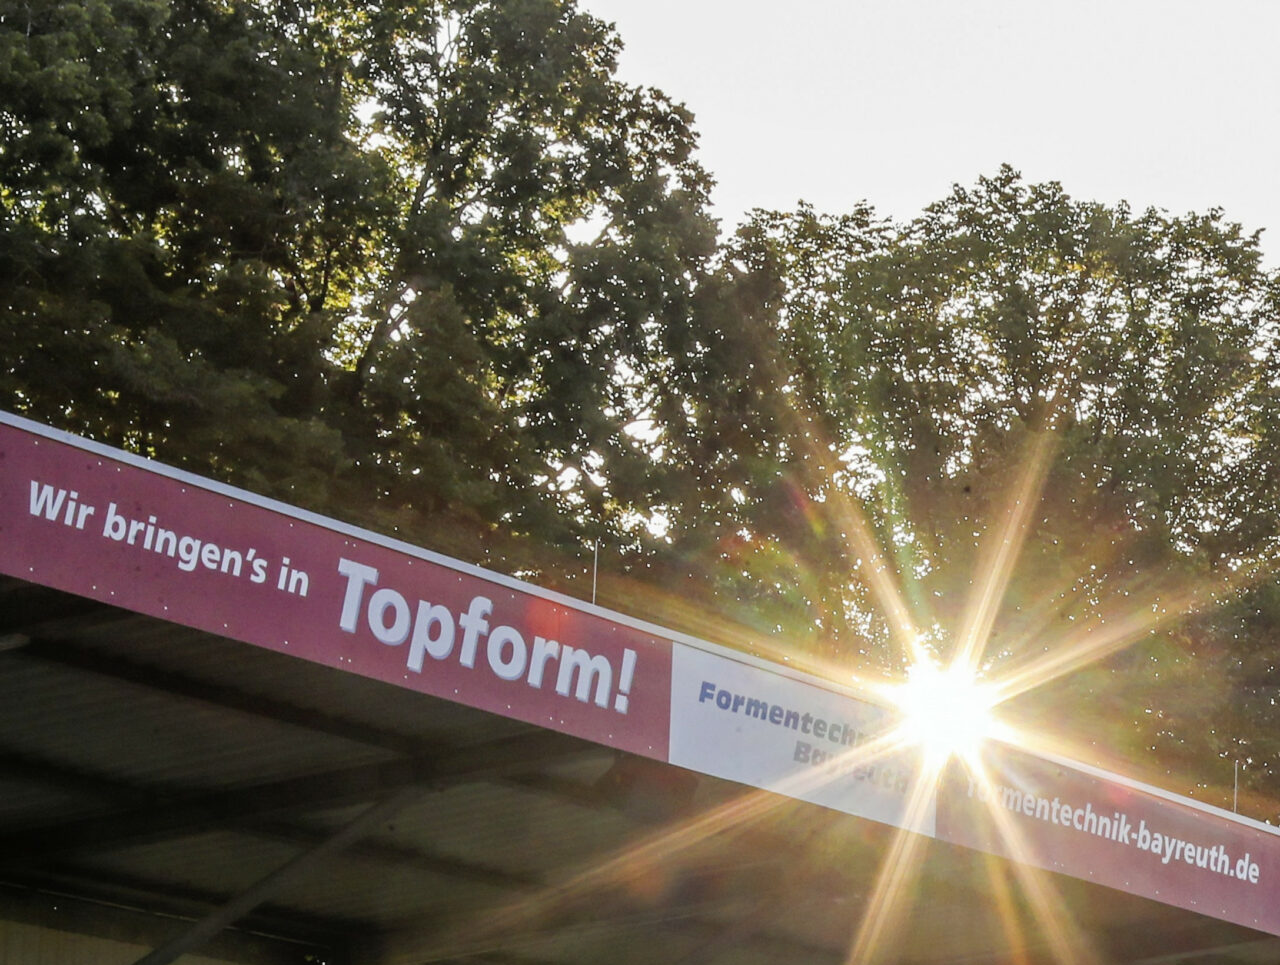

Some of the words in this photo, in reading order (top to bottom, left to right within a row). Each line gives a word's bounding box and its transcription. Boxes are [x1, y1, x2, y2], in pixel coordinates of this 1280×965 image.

[28, 479, 95, 531] Wir
[103, 502, 268, 584] bringen's
[277, 557, 311, 597] in
[337, 557, 638, 714] Topform!
